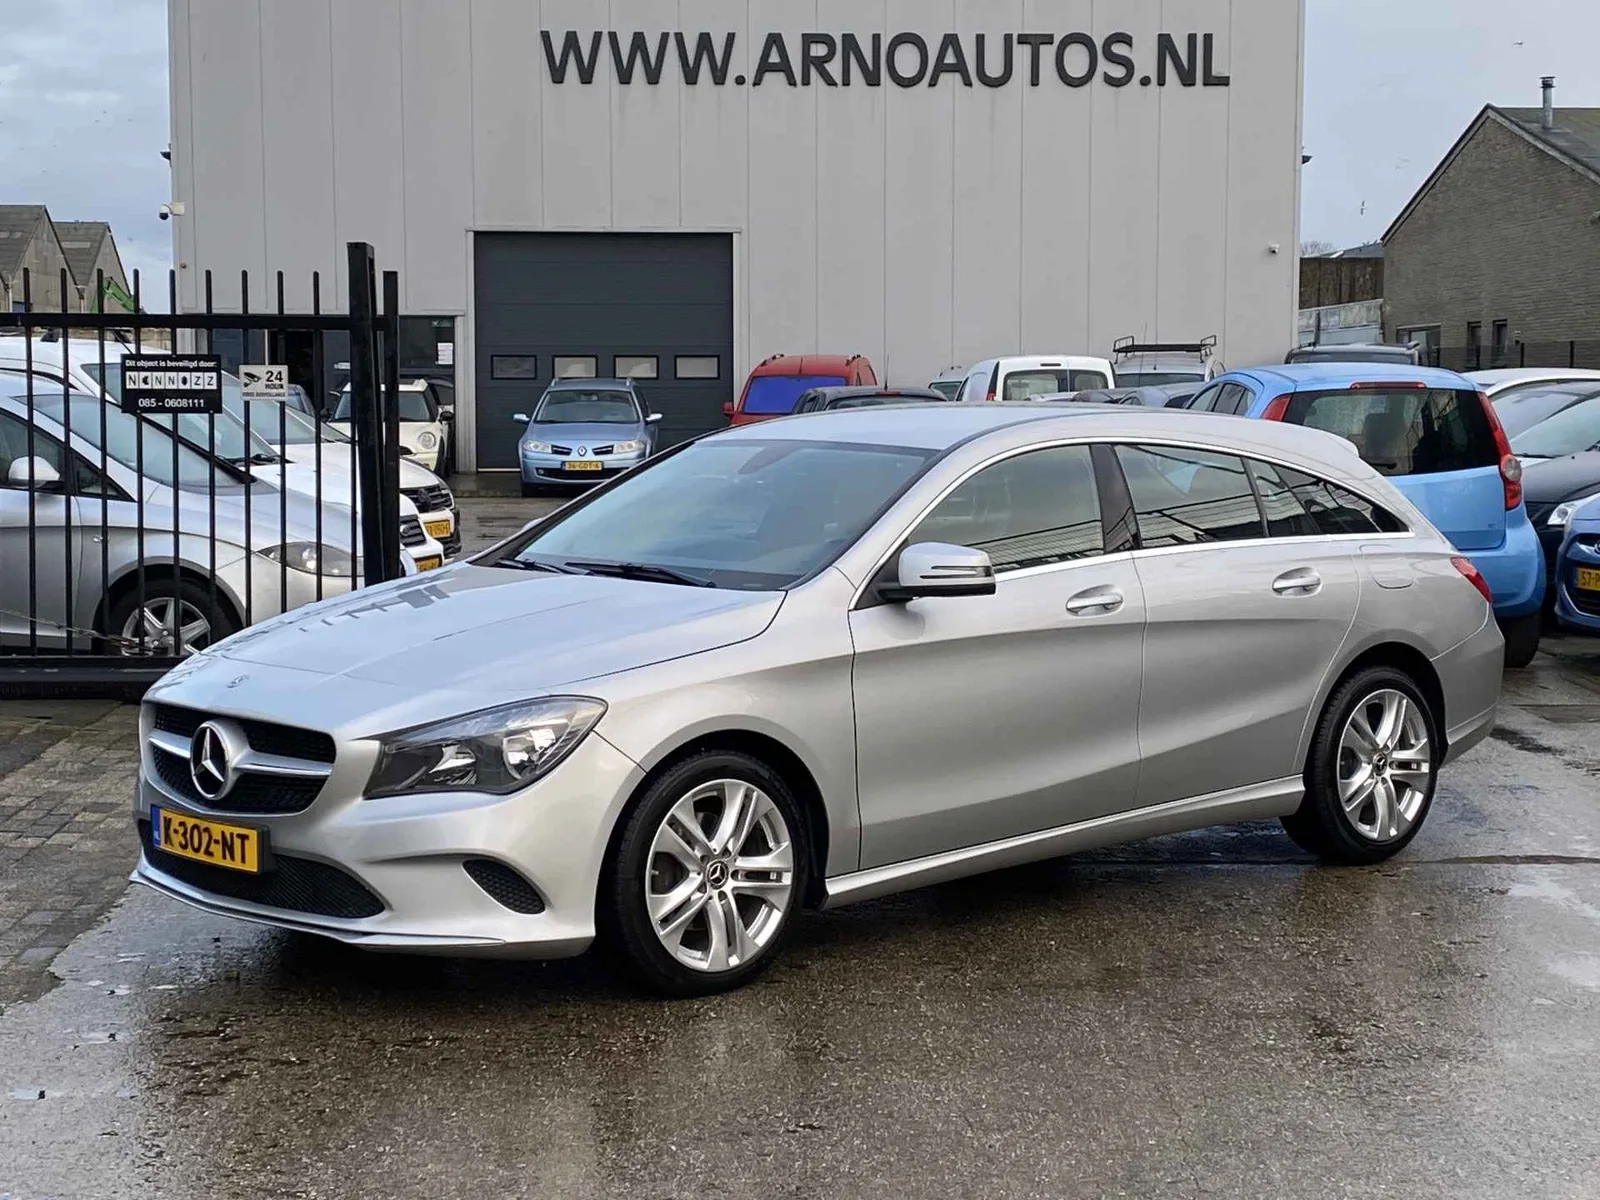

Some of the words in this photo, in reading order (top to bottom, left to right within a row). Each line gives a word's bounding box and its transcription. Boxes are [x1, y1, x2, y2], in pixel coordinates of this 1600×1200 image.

[540, 30, 1231, 88] WWW.ARNOAUTOS.NL
[136, 360, 158, 368] object
[167, 360, 198, 368] beveiligd
[265, 370, 284, 383] 24
[138, 399, 157, 408] 085
[164, 399, 205, 408] 0608111
[162, 815, 250, 864] K-302-NT
